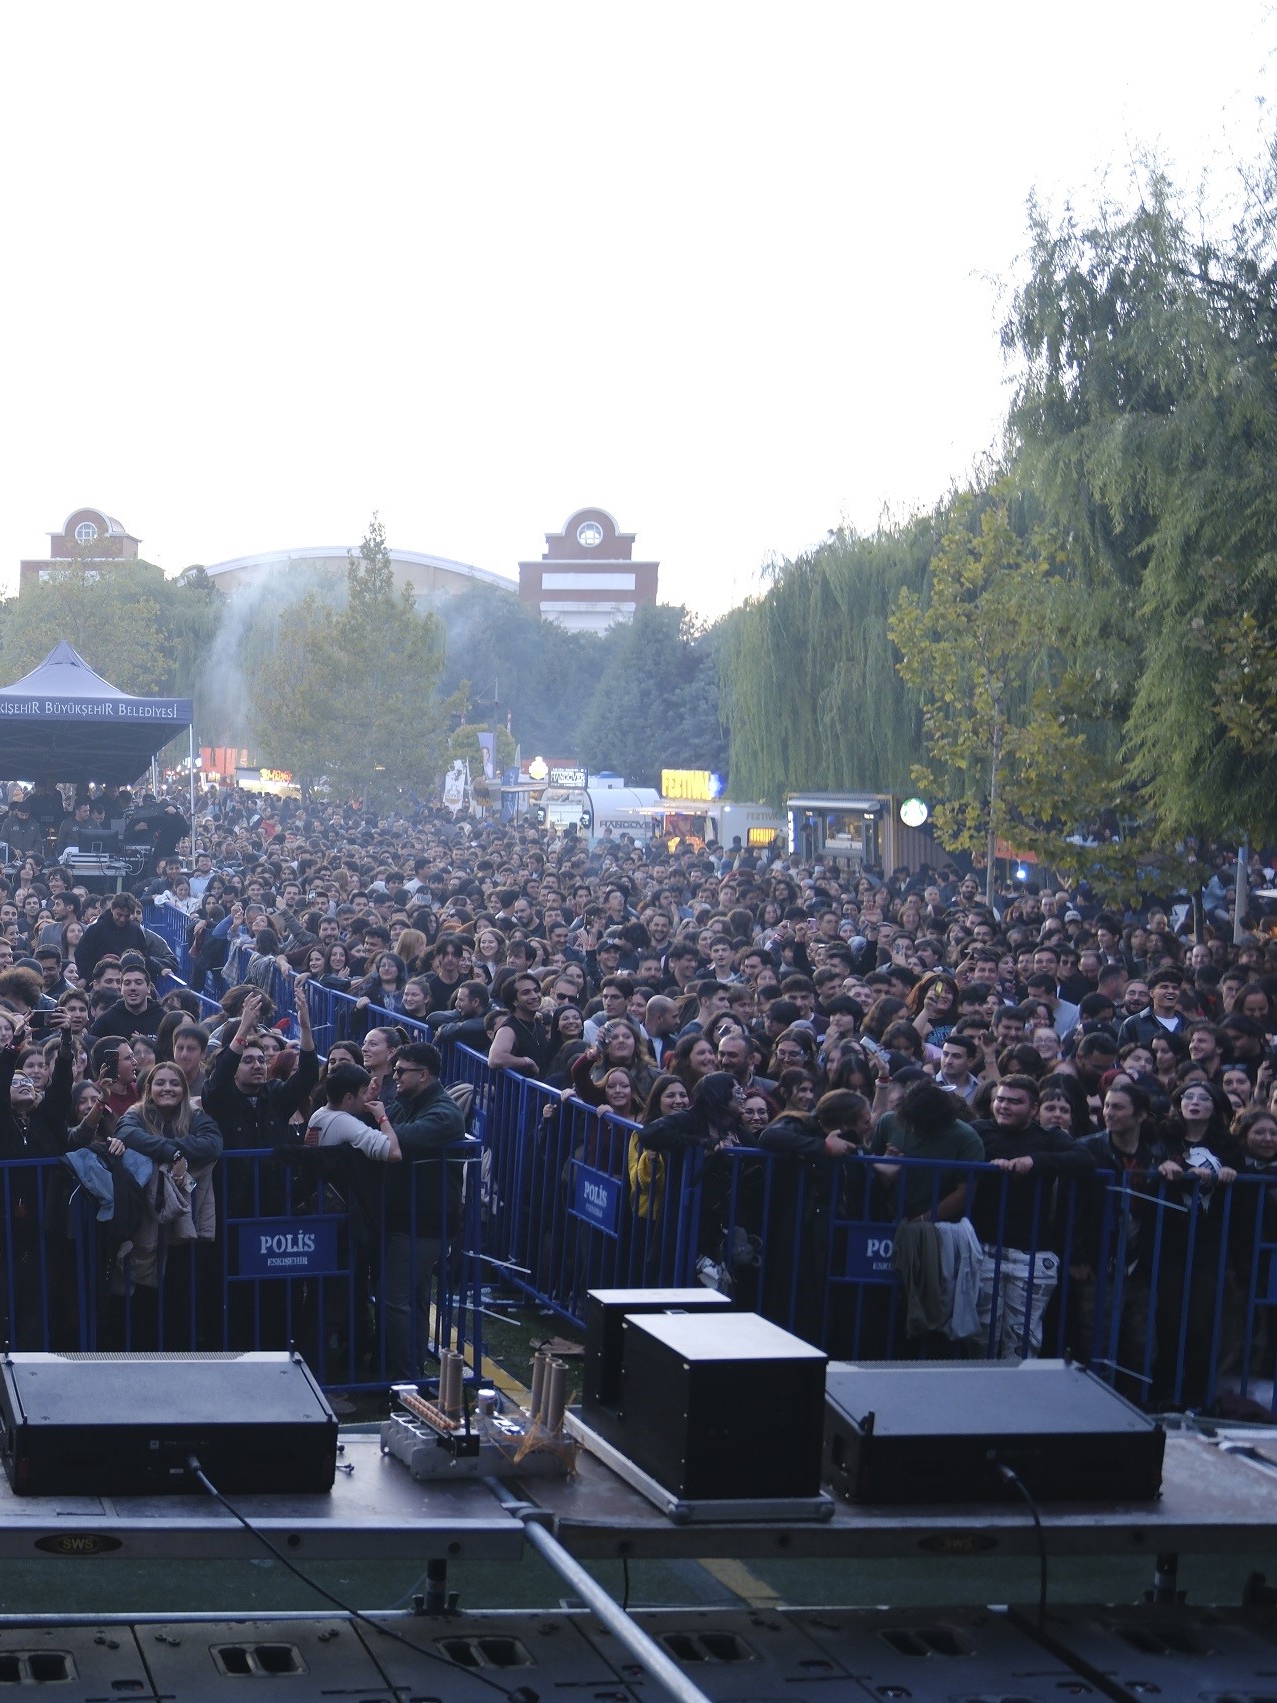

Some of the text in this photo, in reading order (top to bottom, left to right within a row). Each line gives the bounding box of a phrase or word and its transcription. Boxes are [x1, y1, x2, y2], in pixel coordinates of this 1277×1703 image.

[118, 703, 177, 718] BELEDİYESİ
[583, 1180, 608, 1208] POLİS
[259, 1229, 315, 1254] POLİS
[62, 1537, 94, 1550] SWS
